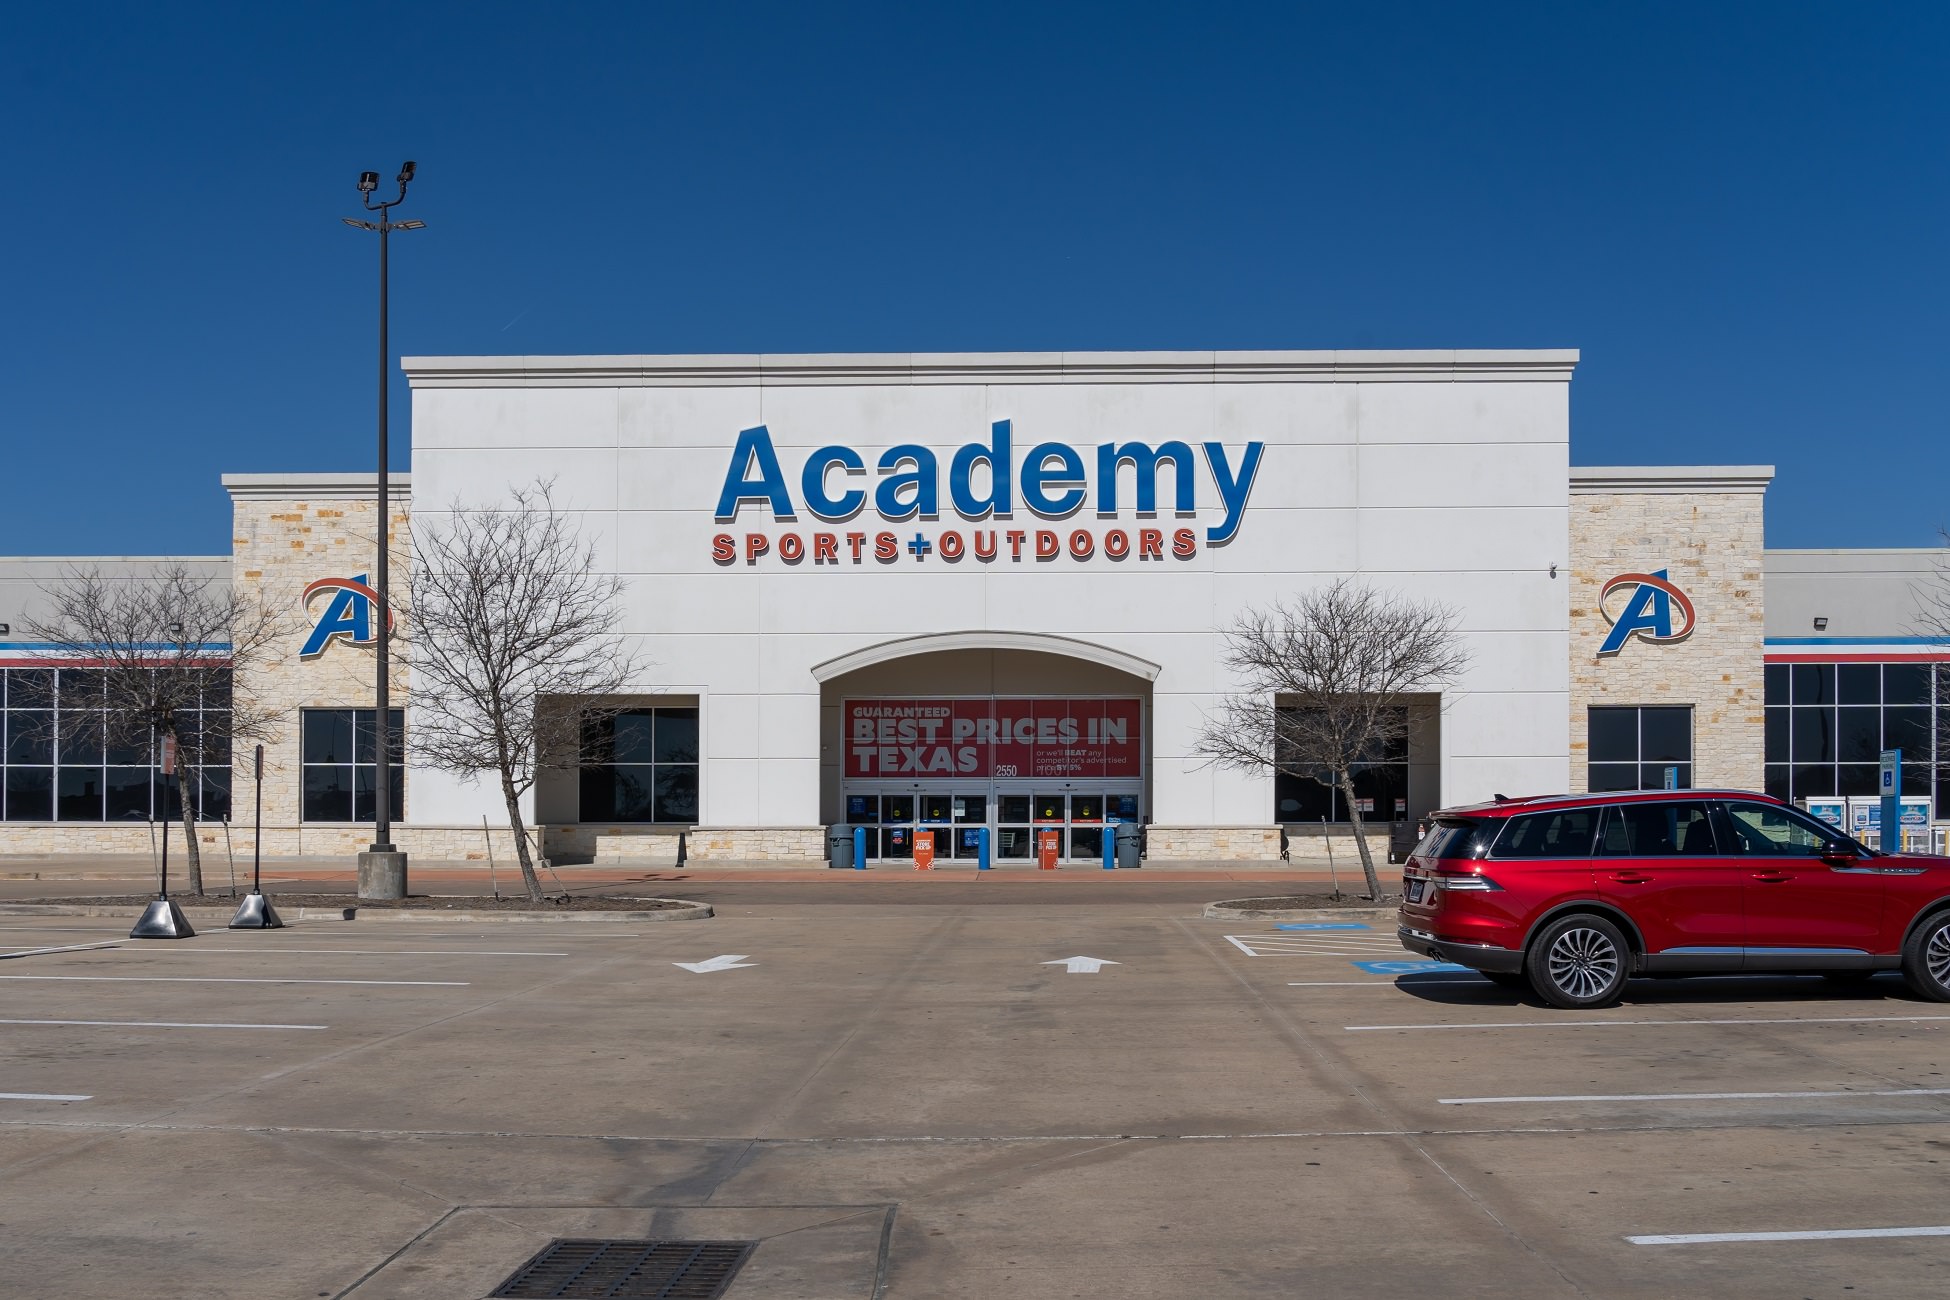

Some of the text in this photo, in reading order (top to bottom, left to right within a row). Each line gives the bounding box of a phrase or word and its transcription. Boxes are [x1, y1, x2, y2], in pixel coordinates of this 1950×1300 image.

[714, 418, 1265, 543] Academy
[853, 707, 950, 718] GUARANTEED
[852, 718, 1128, 744] BEST PRICES IN
[853, 747, 977, 772] TEXAS
[1064, 749, 1087, 757] BEAT
[995, 765, 1018, 777] 2550
